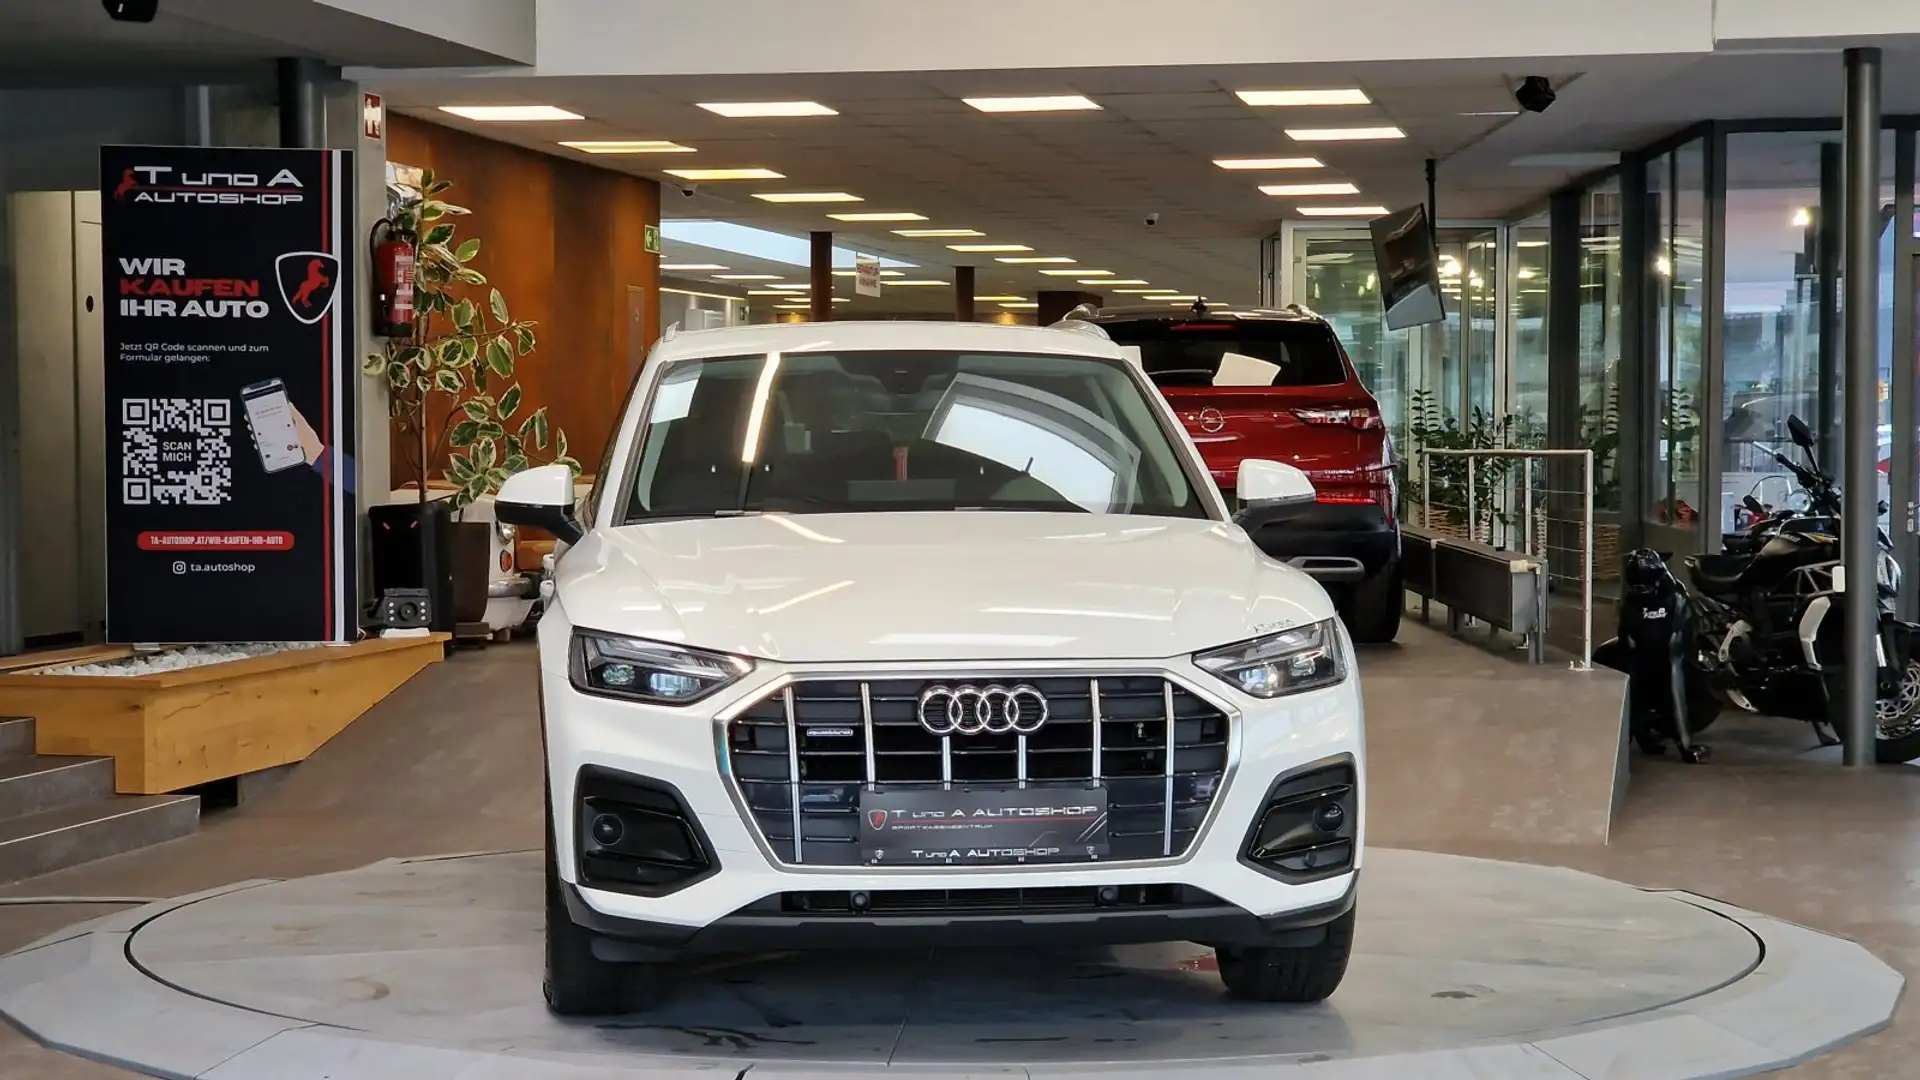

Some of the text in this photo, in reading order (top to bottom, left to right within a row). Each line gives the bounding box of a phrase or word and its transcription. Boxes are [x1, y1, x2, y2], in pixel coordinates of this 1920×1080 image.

[133, 165, 173, 185] T
[266, 168, 304, 188] A
[134, 191, 304, 205] AUTOSHOP
[119, 257, 186, 276] WIR
[119, 278, 260, 297] KAUFEN
[119, 299, 270, 318] IHR AUTO
[120, 342, 143, 351] Jetzt
[144, 343, 159, 352] QR
[161, 343, 185, 352] Code
[187, 344, 226, 352] scannen
[228, 344, 247, 352] und
[120, 353, 211, 363] Formular gelangen:
[162, 441, 192, 451] SCAN
[162, 452, 192, 462] MICH
[190, 562, 256, 574] ta.autoshop
[891, 809, 906, 818] T
[951, 808, 966, 818] A
[972, 805, 1098, 819] AUTOSHOP
[967, 847, 1060, 858] AUTOSHOP
